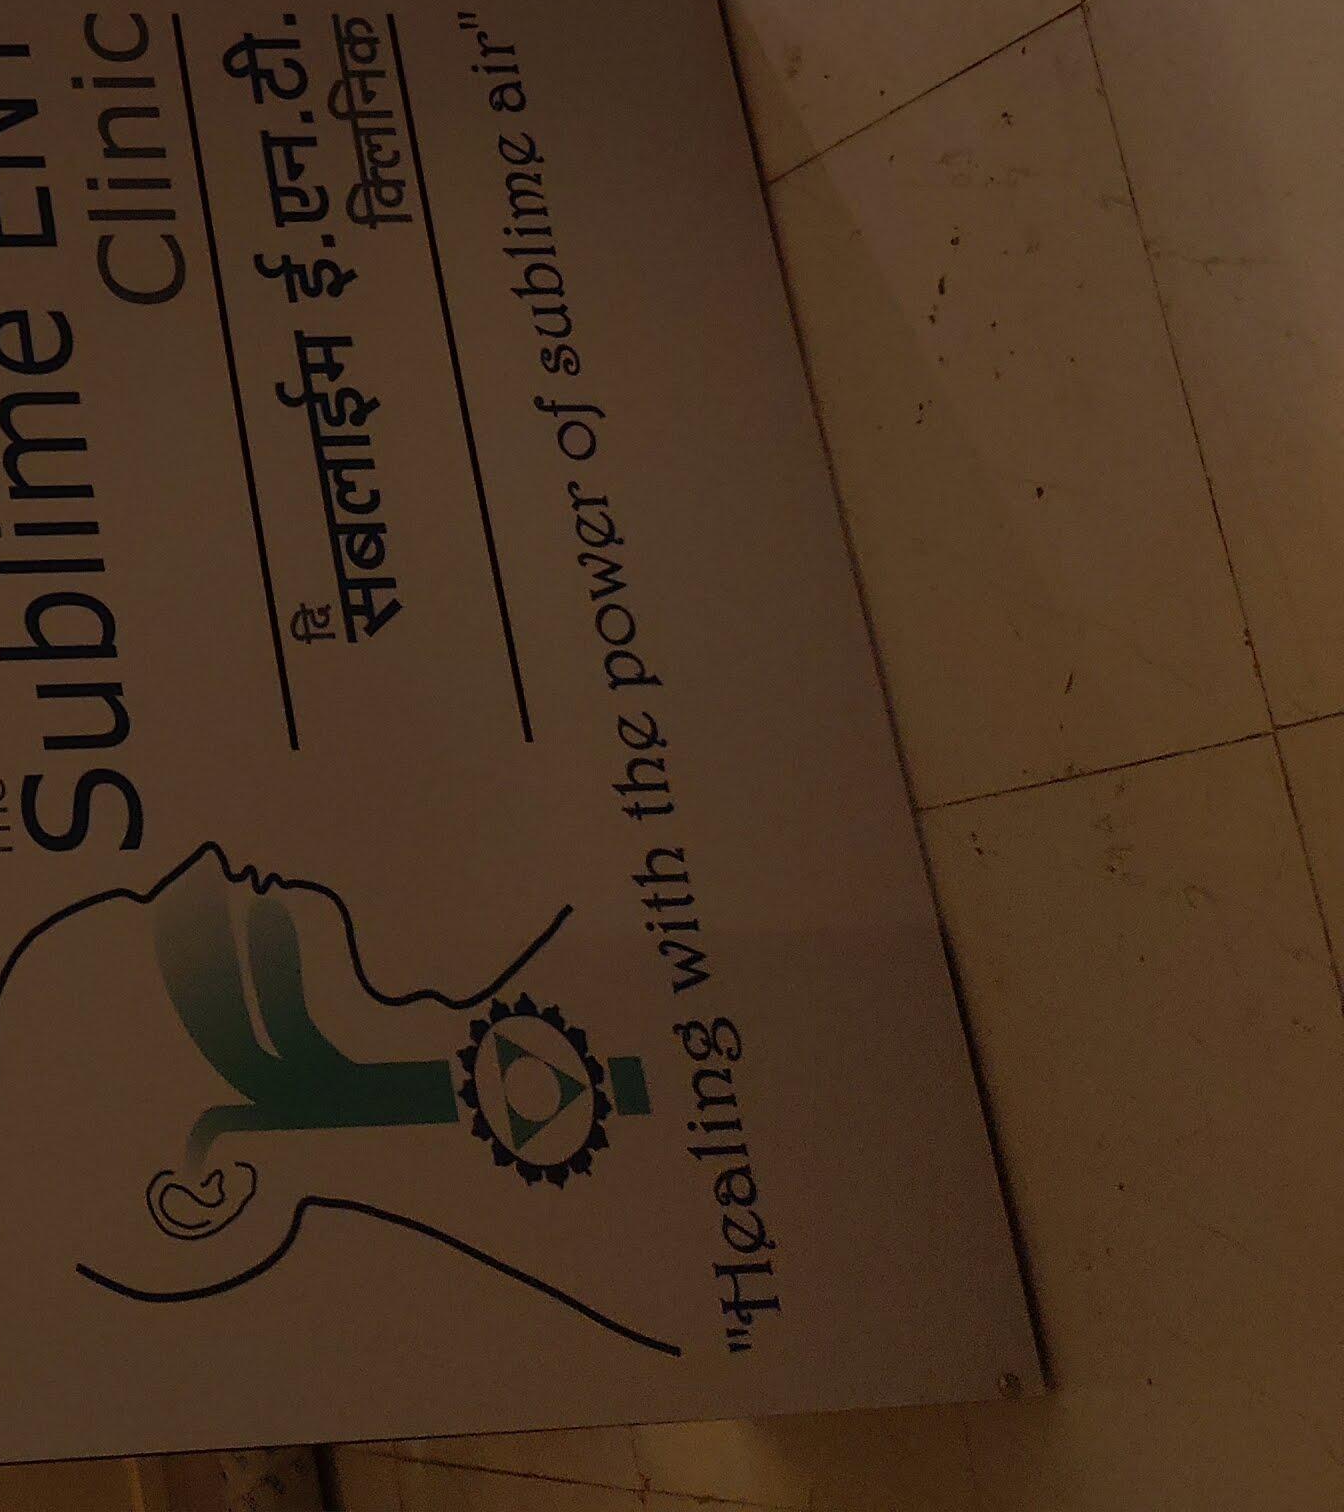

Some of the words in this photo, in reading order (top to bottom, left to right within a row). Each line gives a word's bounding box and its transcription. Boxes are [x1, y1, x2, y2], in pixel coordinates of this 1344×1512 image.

[71, 13, 187, 305] Clinic
[222, 13, 358, 304] ई.एन.टी.
[327, 12, 414, 230] क्लिनिक
[457, 11, 528, 113] air"
[498, 131, 582, 377] sublime
[275, 329, 404, 644] सबलाईम
[534, 395, 606, 462] of
[289, 602, 337, 644] दि
[568, 480, 664, 690] power
[613, 711, 675, 822] the
[631, 847, 712, 994] with
[673, 1016, 782, 1354] "Healing
